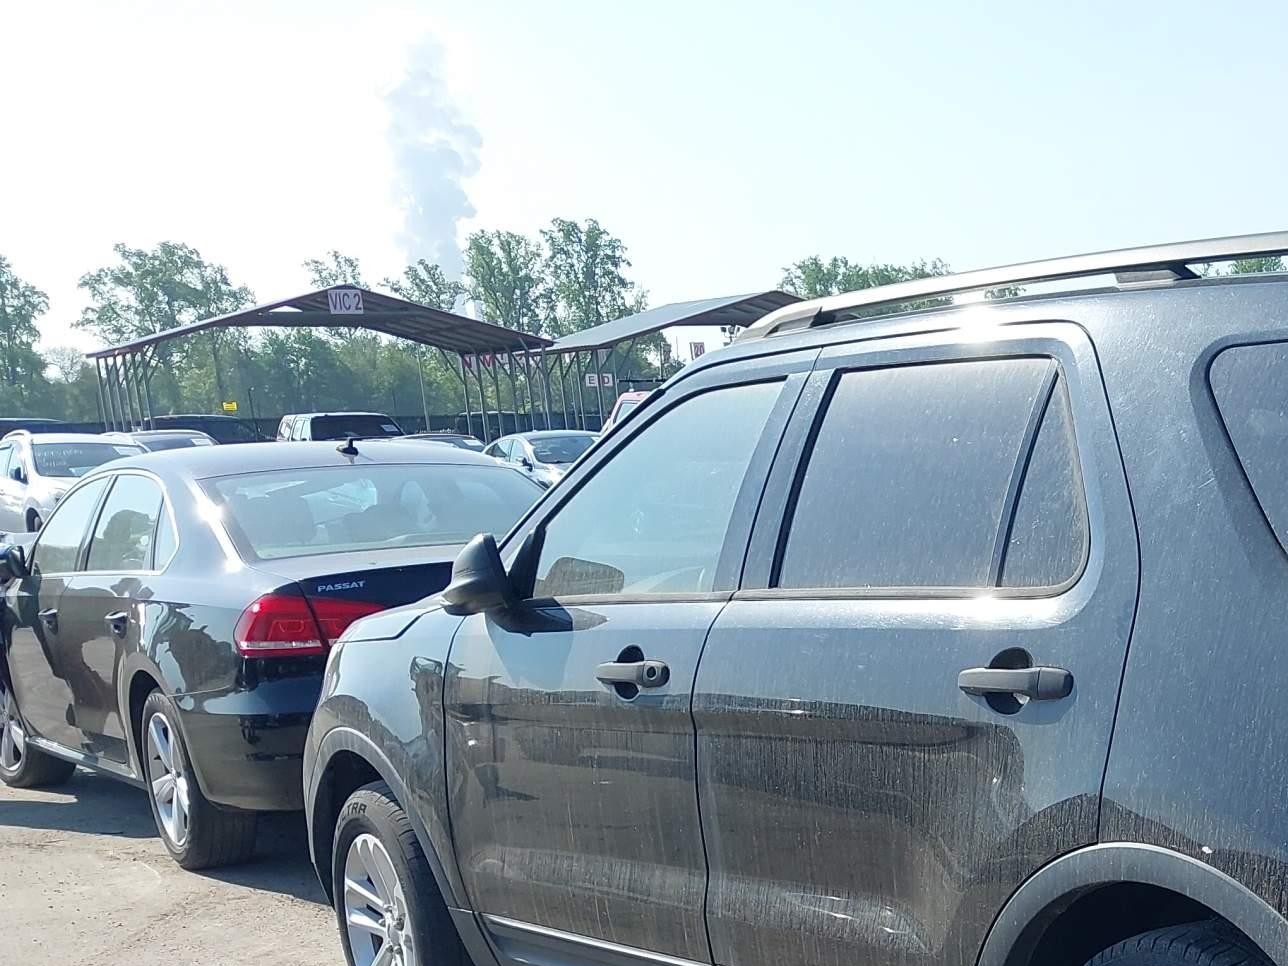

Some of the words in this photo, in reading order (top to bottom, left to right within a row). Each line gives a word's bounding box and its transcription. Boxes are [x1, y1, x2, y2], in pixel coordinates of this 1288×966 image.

[329, 292, 352, 311] VIC
[353, 292, 362, 311] 2
[588, 375, 610, 385] ED
[317, 580, 366, 593] PASSAT
